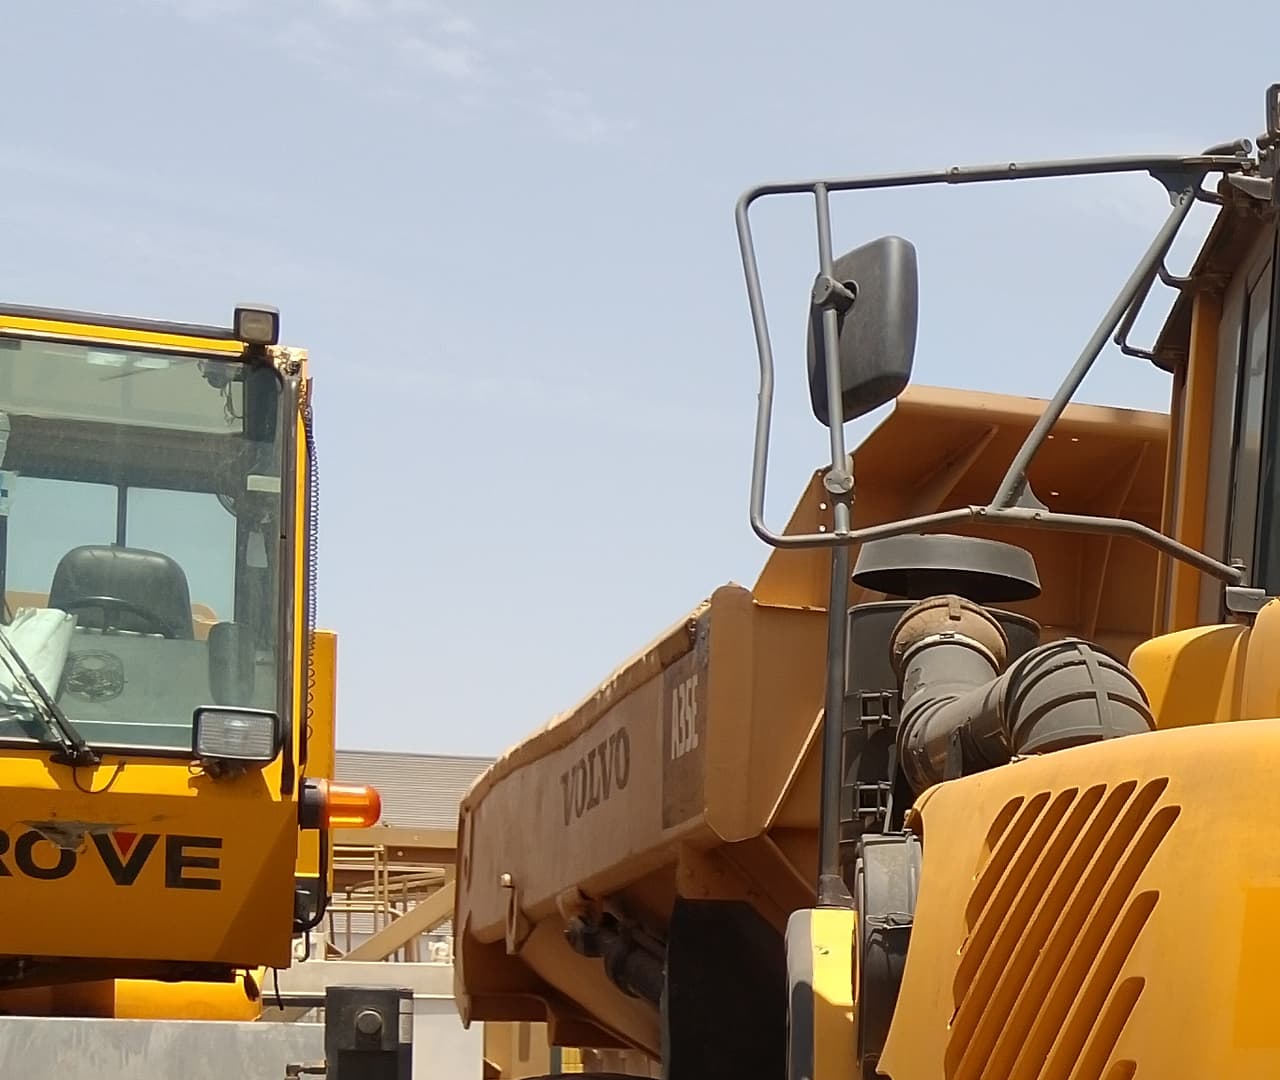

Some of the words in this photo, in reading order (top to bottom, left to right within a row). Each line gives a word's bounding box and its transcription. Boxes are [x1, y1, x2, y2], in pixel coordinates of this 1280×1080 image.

[671, 674, 699, 760] A35E
[560, 726, 630, 827] VOLVO
[0, 828, 223, 890] OVE
